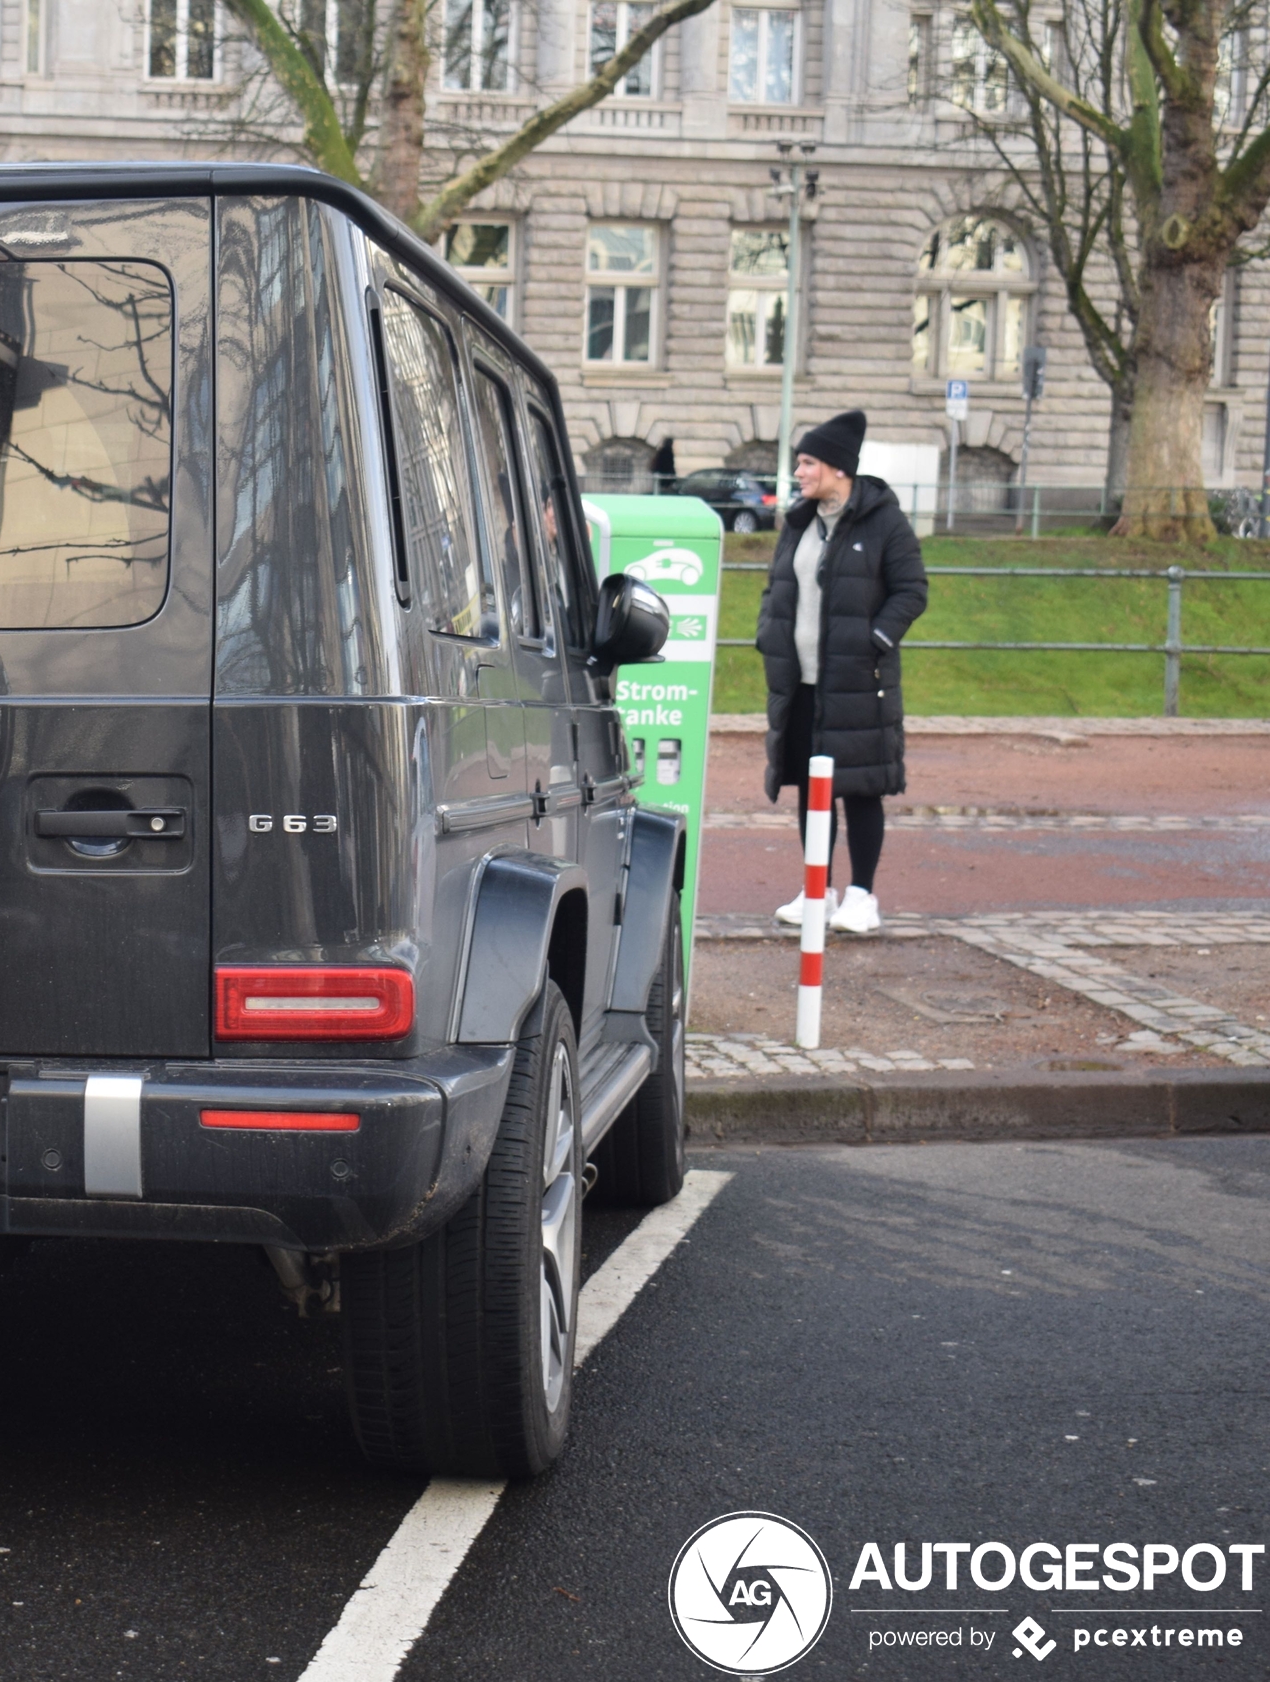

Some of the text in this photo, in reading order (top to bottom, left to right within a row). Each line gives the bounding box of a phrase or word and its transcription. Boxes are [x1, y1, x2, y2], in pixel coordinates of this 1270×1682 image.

[616, 680, 699, 701] Strom-
[248, 814, 338, 833] G 63
